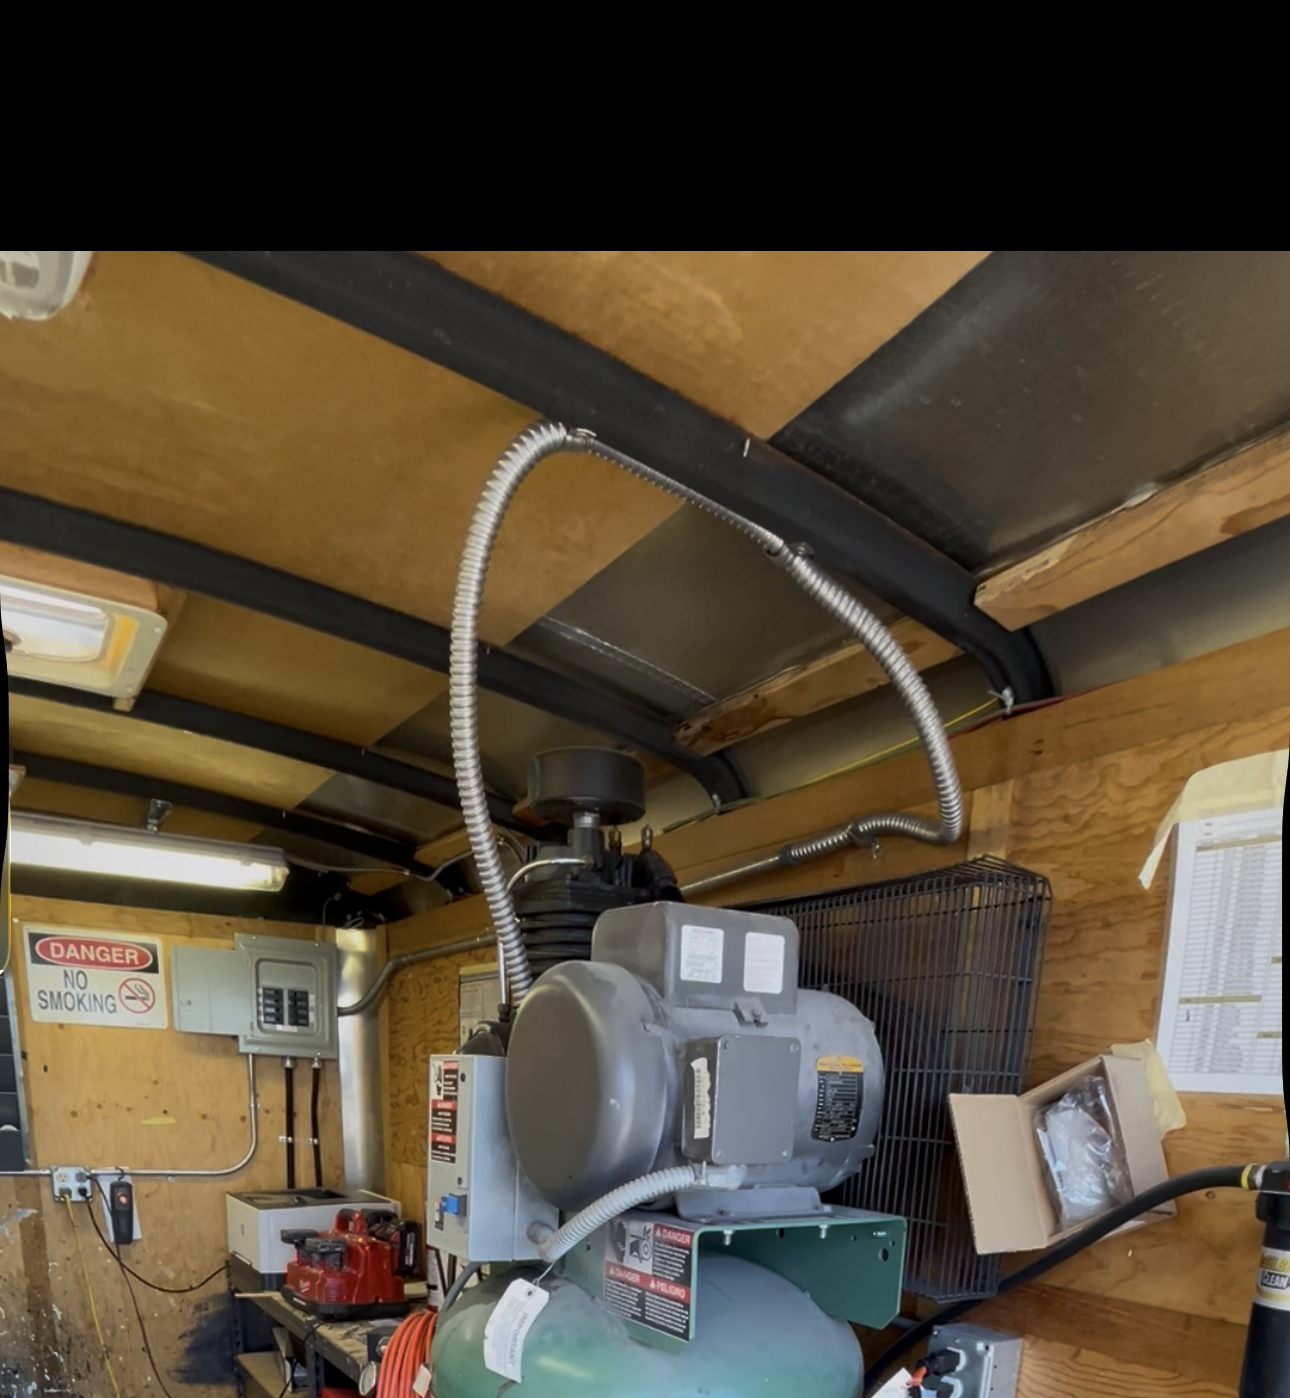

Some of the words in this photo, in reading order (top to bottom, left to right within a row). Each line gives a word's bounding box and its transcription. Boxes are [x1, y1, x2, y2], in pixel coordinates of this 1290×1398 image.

[49, 942, 139, 965] DANGER
[63, 969, 88, 990] NO
[37, 989, 117, 1014] SMOKING
[662, 1230, 690, 1245] DANGER
[656, 1281, 687, 1299] PELIGRO
